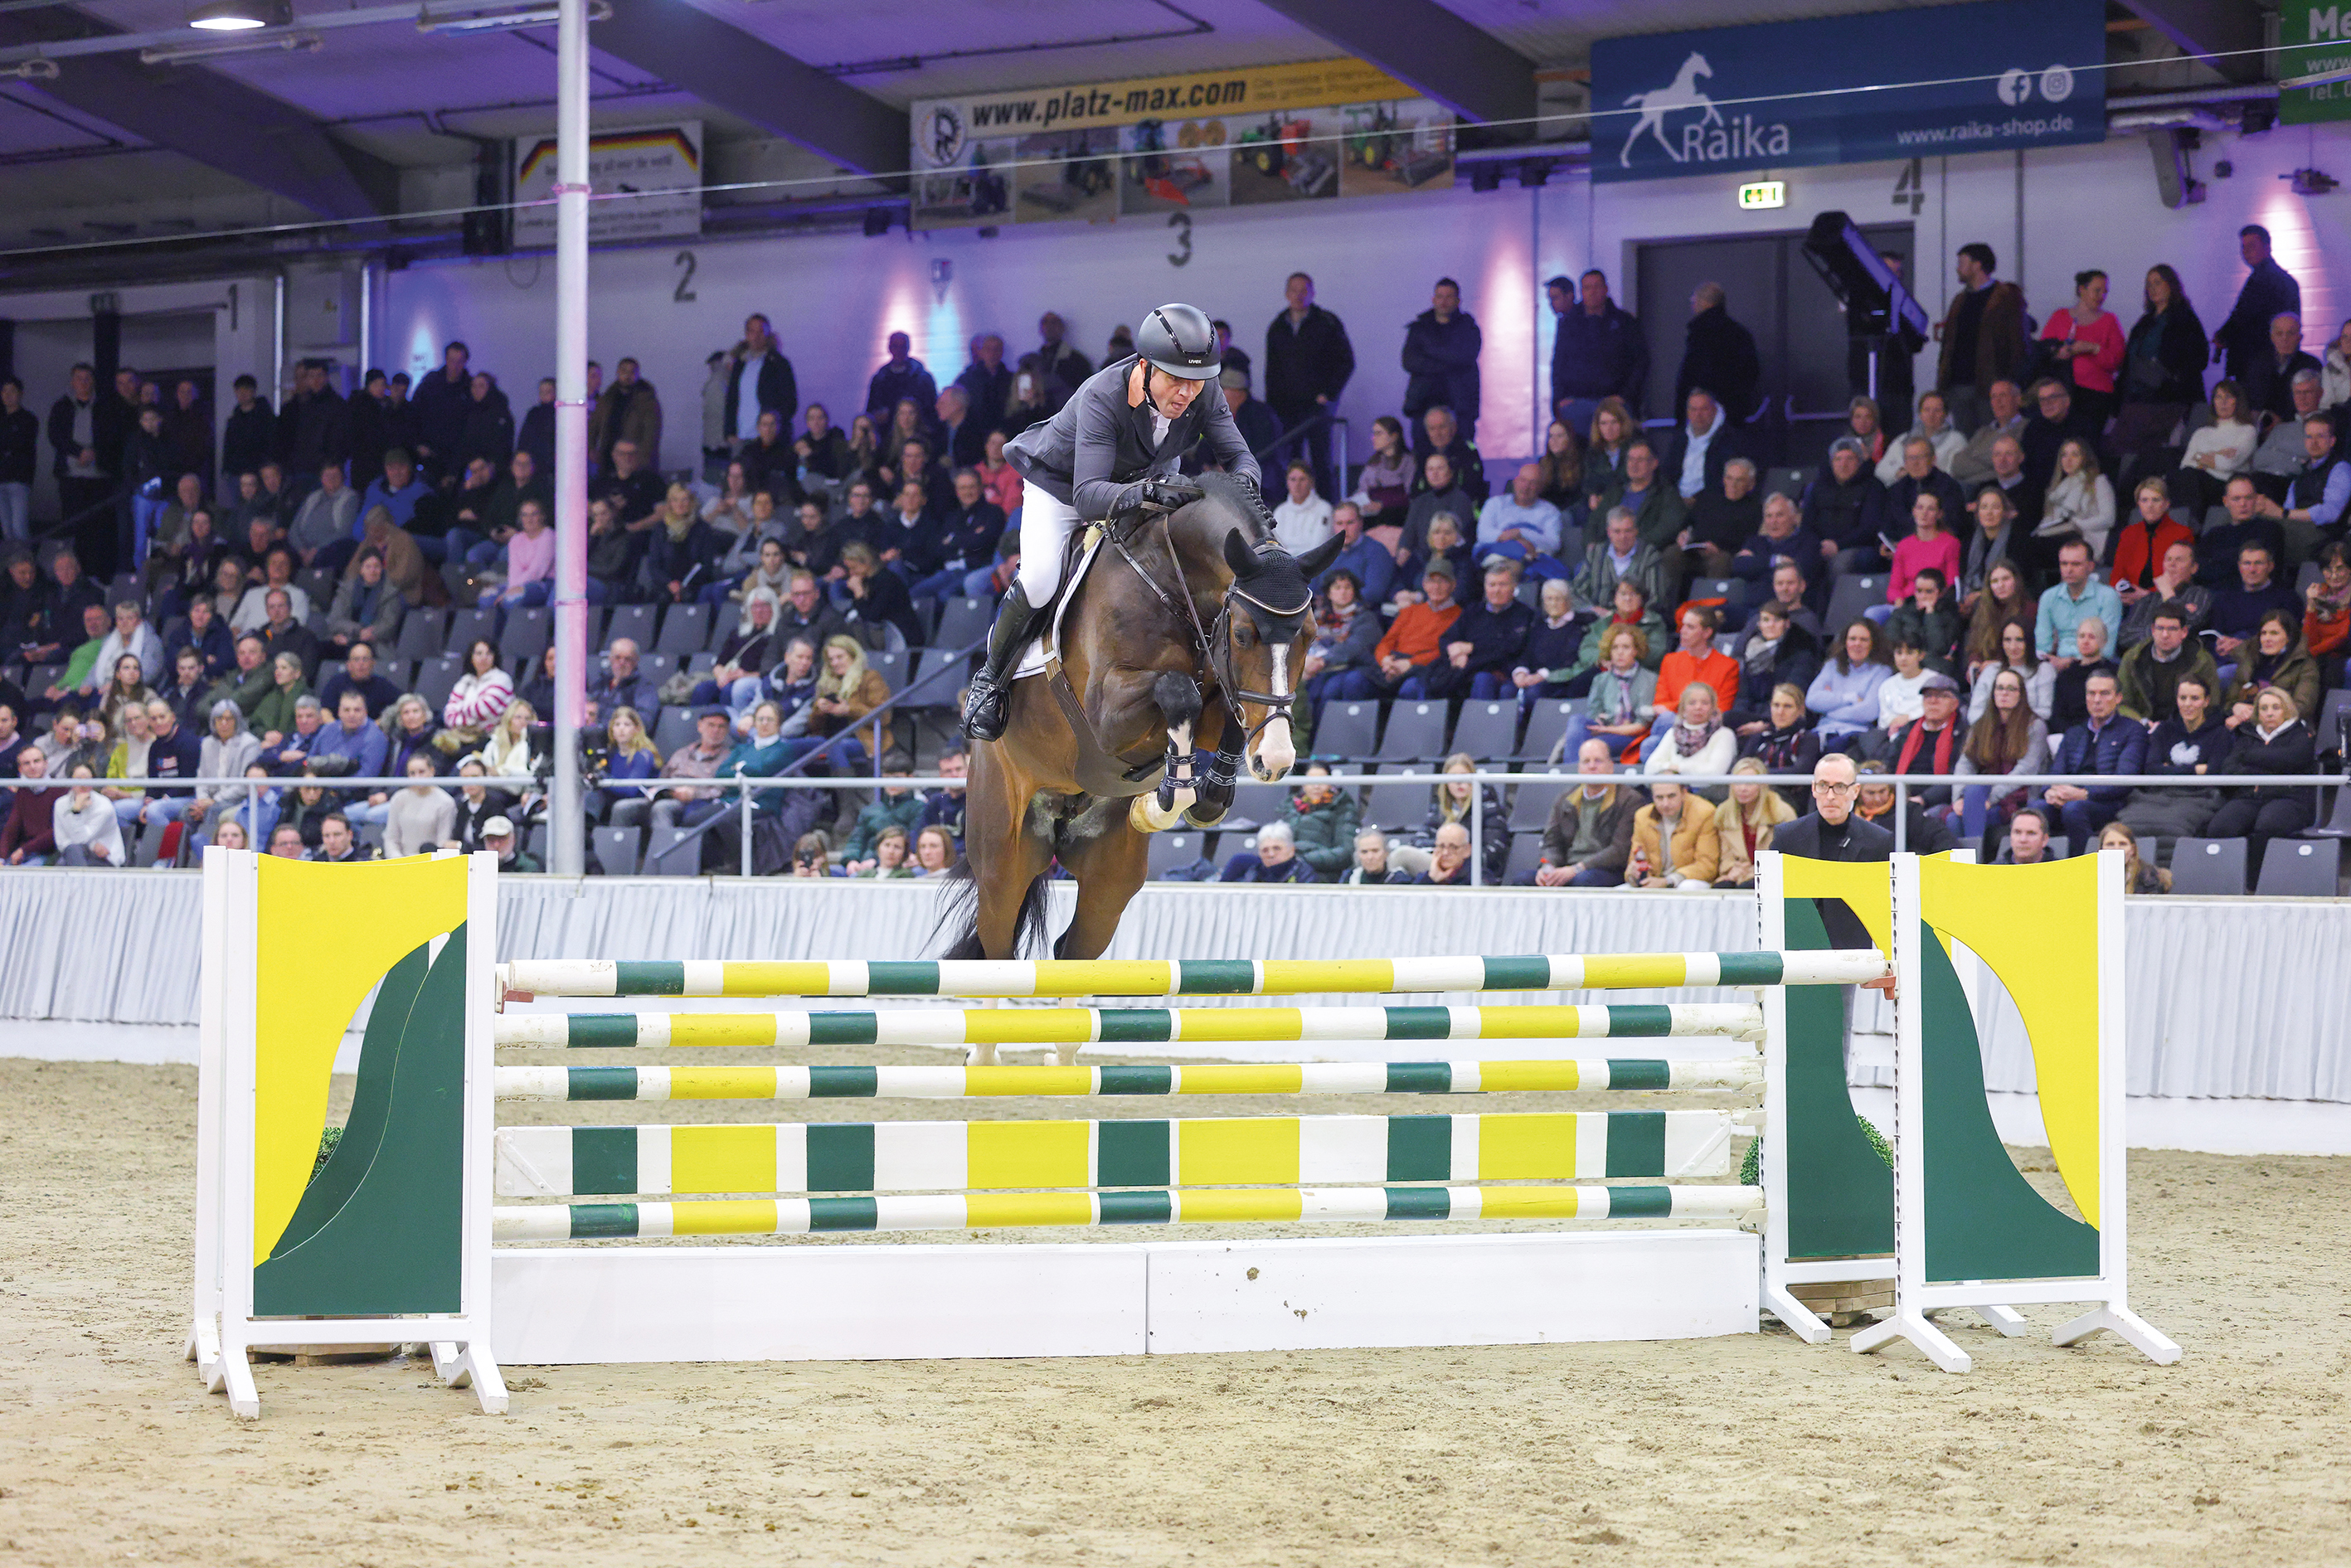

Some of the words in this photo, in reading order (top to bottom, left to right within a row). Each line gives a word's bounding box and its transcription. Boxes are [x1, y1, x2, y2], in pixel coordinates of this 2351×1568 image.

[974, 80, 1246, 128] www.platz-max.com
[1683, 114, 1790, 162] Raika
[1897, 114, 2073, 145] www.raika-shop.de
[1892, 158, 1925, 216] 4
[1168, 212, 1192, 267] 3
[673, 251, 697, 303] 2
[228, 284, 238, 331] 1
